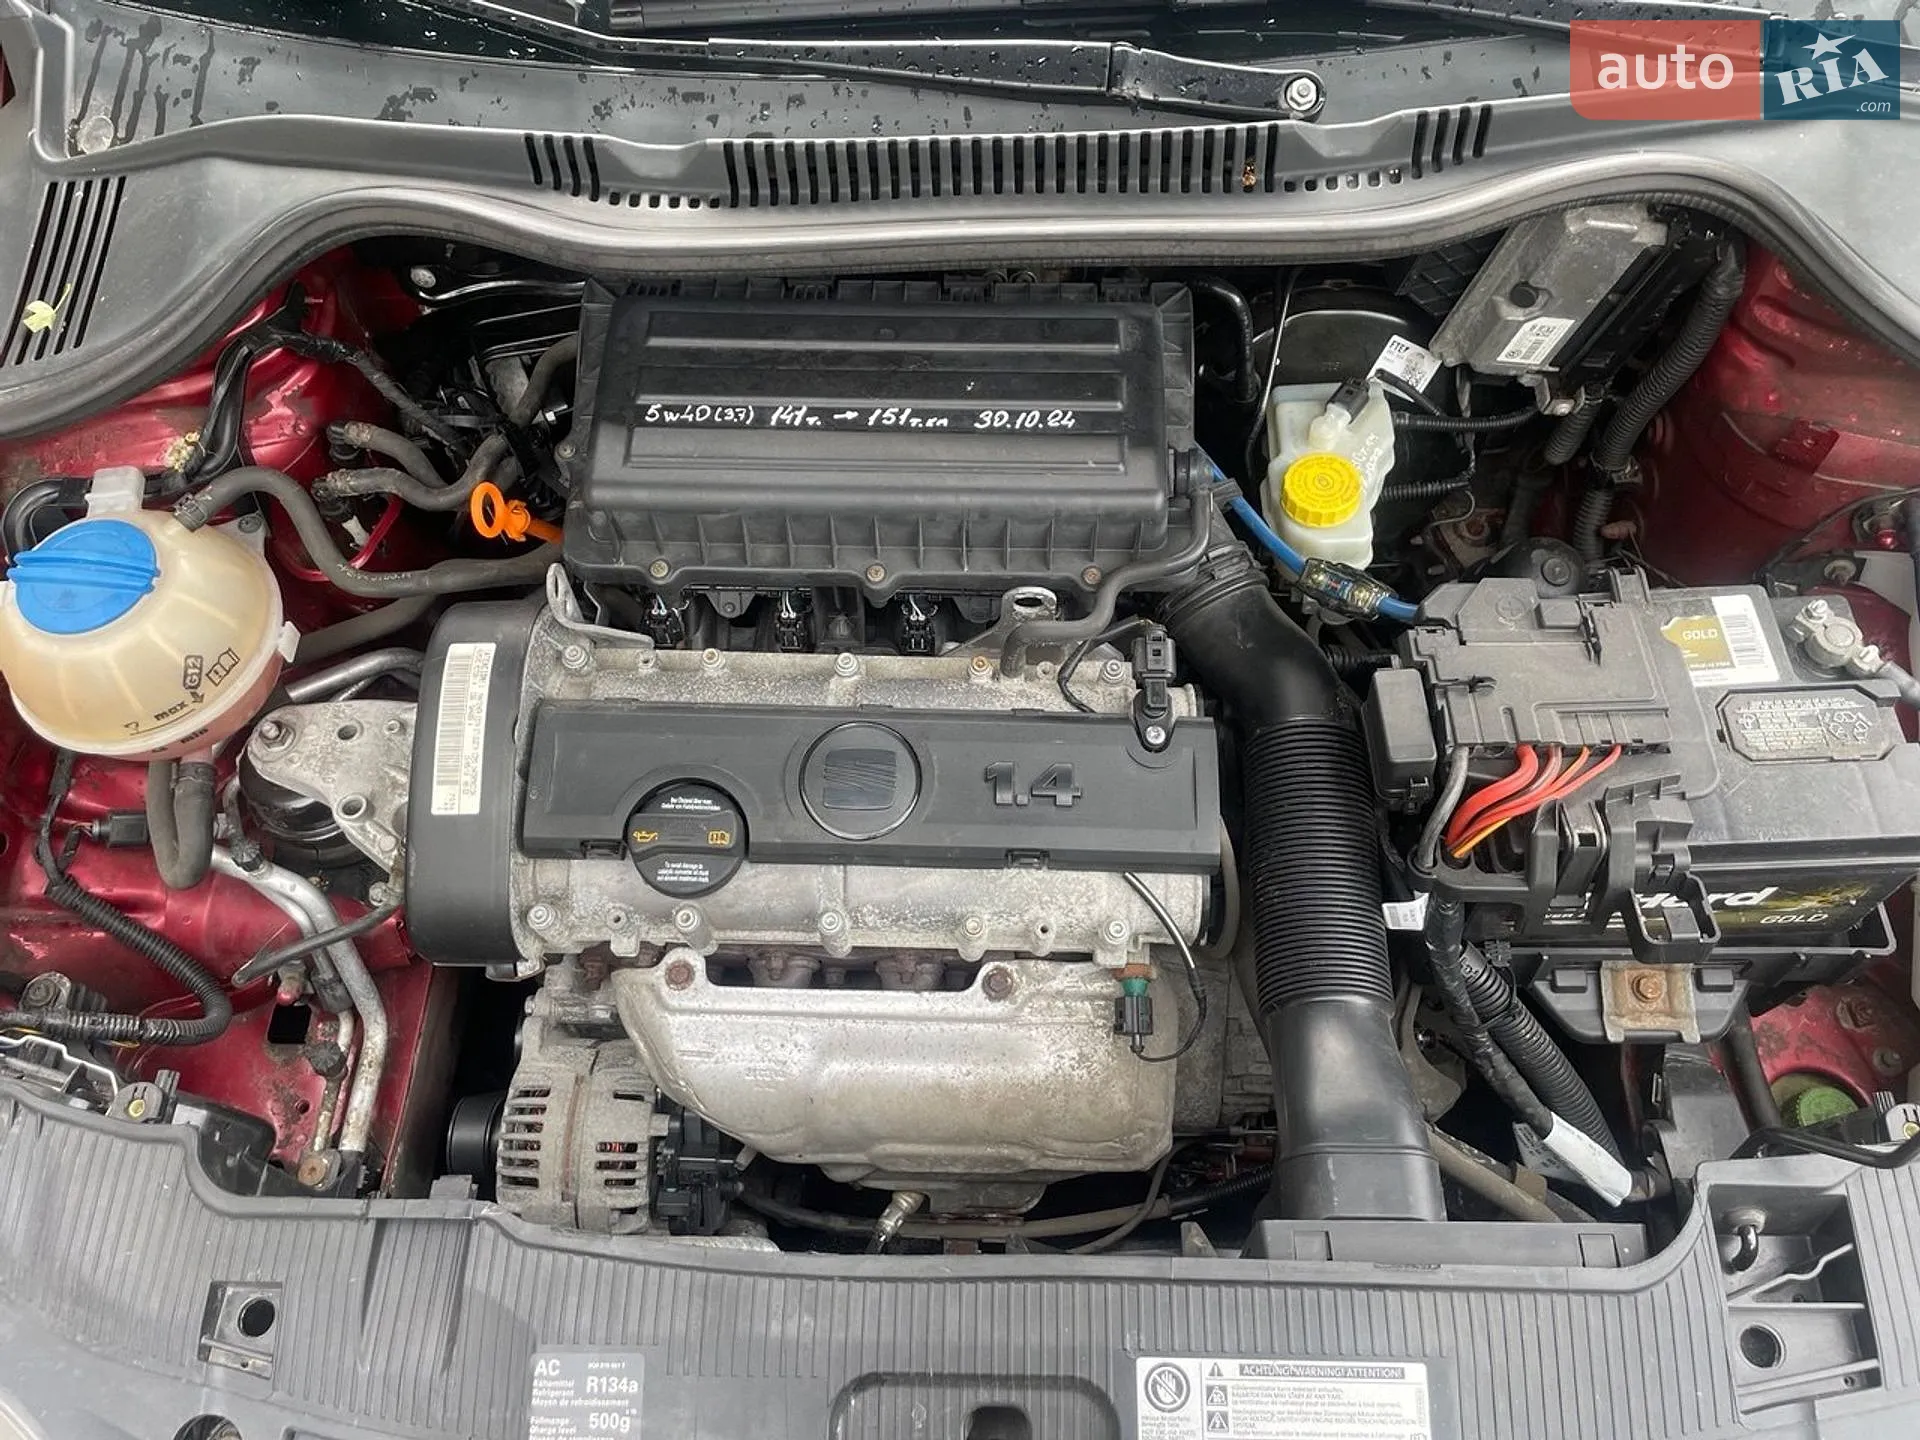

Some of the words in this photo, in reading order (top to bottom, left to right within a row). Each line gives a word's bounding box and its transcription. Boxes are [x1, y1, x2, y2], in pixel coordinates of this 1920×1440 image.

[973, 409, 1076, 429] 30.10.24
[1682, 628, 1719, 641] GOLD
[153, 701, 189, 721] max
[984, 761, 1082, 807] 1.4
[1759, 913, 1830, 925] GOLD
[534, 1359, 561, 1377] AC
[586, 1375, 639, 1394] R134a
[589, 1412, 631, 1434] 500g
